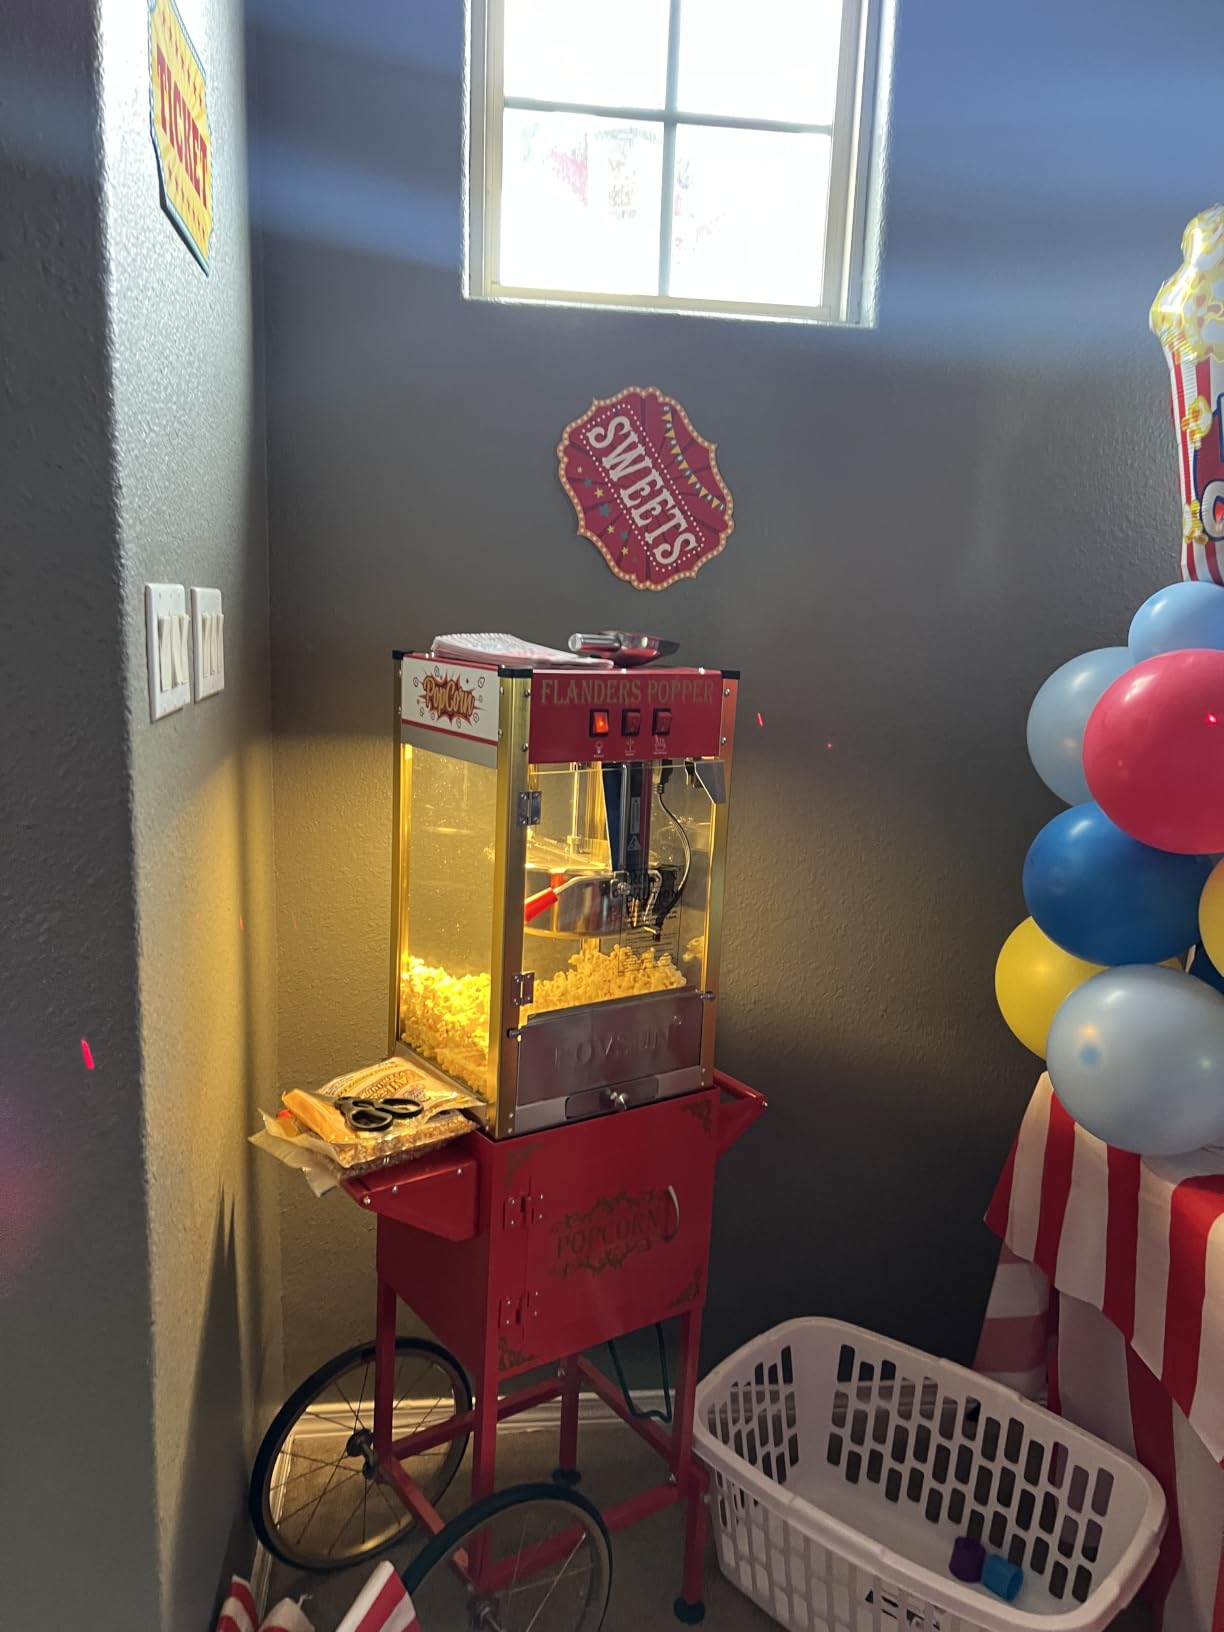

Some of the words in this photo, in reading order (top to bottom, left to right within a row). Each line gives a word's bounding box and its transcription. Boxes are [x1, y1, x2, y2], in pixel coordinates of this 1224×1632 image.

[157, 43, 208, 210] TICKET
[586, 415, 699, 565] SWEETS
[423, 676, 474, 718] PopCorn
[541, 679, 641, 704] FLANDERS
[648, 679, 714, 704] POPPER
[556, 1209, 658, 1259] POPCORN
